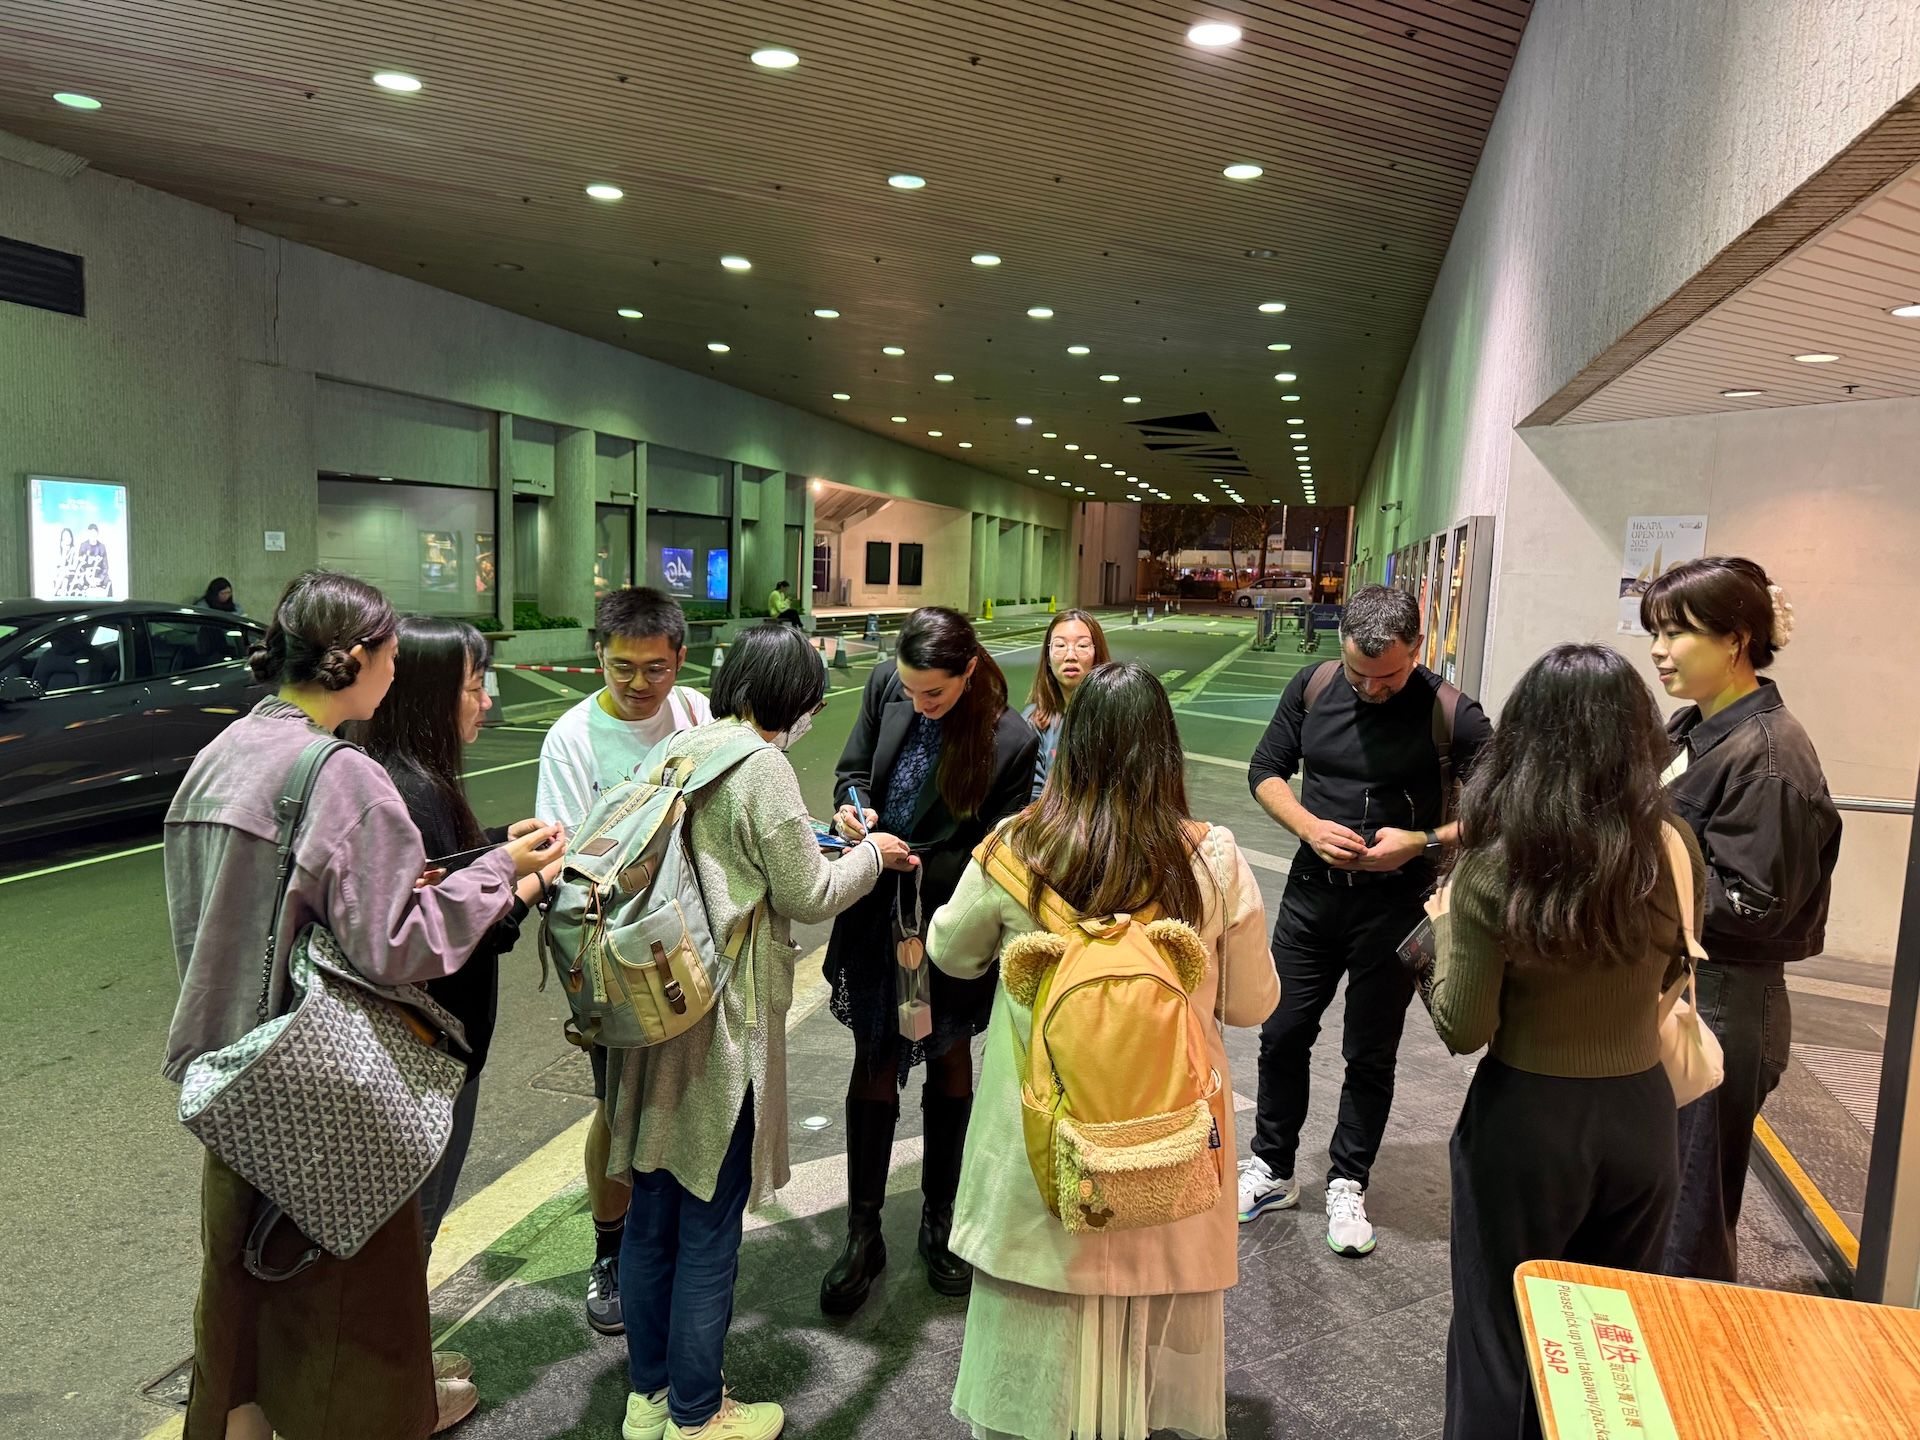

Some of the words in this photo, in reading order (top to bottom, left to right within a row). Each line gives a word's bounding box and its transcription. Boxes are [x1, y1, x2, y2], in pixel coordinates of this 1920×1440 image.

[1632, 521, 1662, 530] HKAPA
[1631, 530, 1655, 539] OPEN
[1656, 530, 1674, 539] DAY
[1630, 539, 1649, 548] 2025
[1557, 1284, 1573, 1310] Please
[1560, 1310, 1582, 1328] pick
[1567, 1329, 1581, 1340] up
[1542, 1338, 1569, 1374] ASAP
[1569, 1341, 1587, 1361] your
